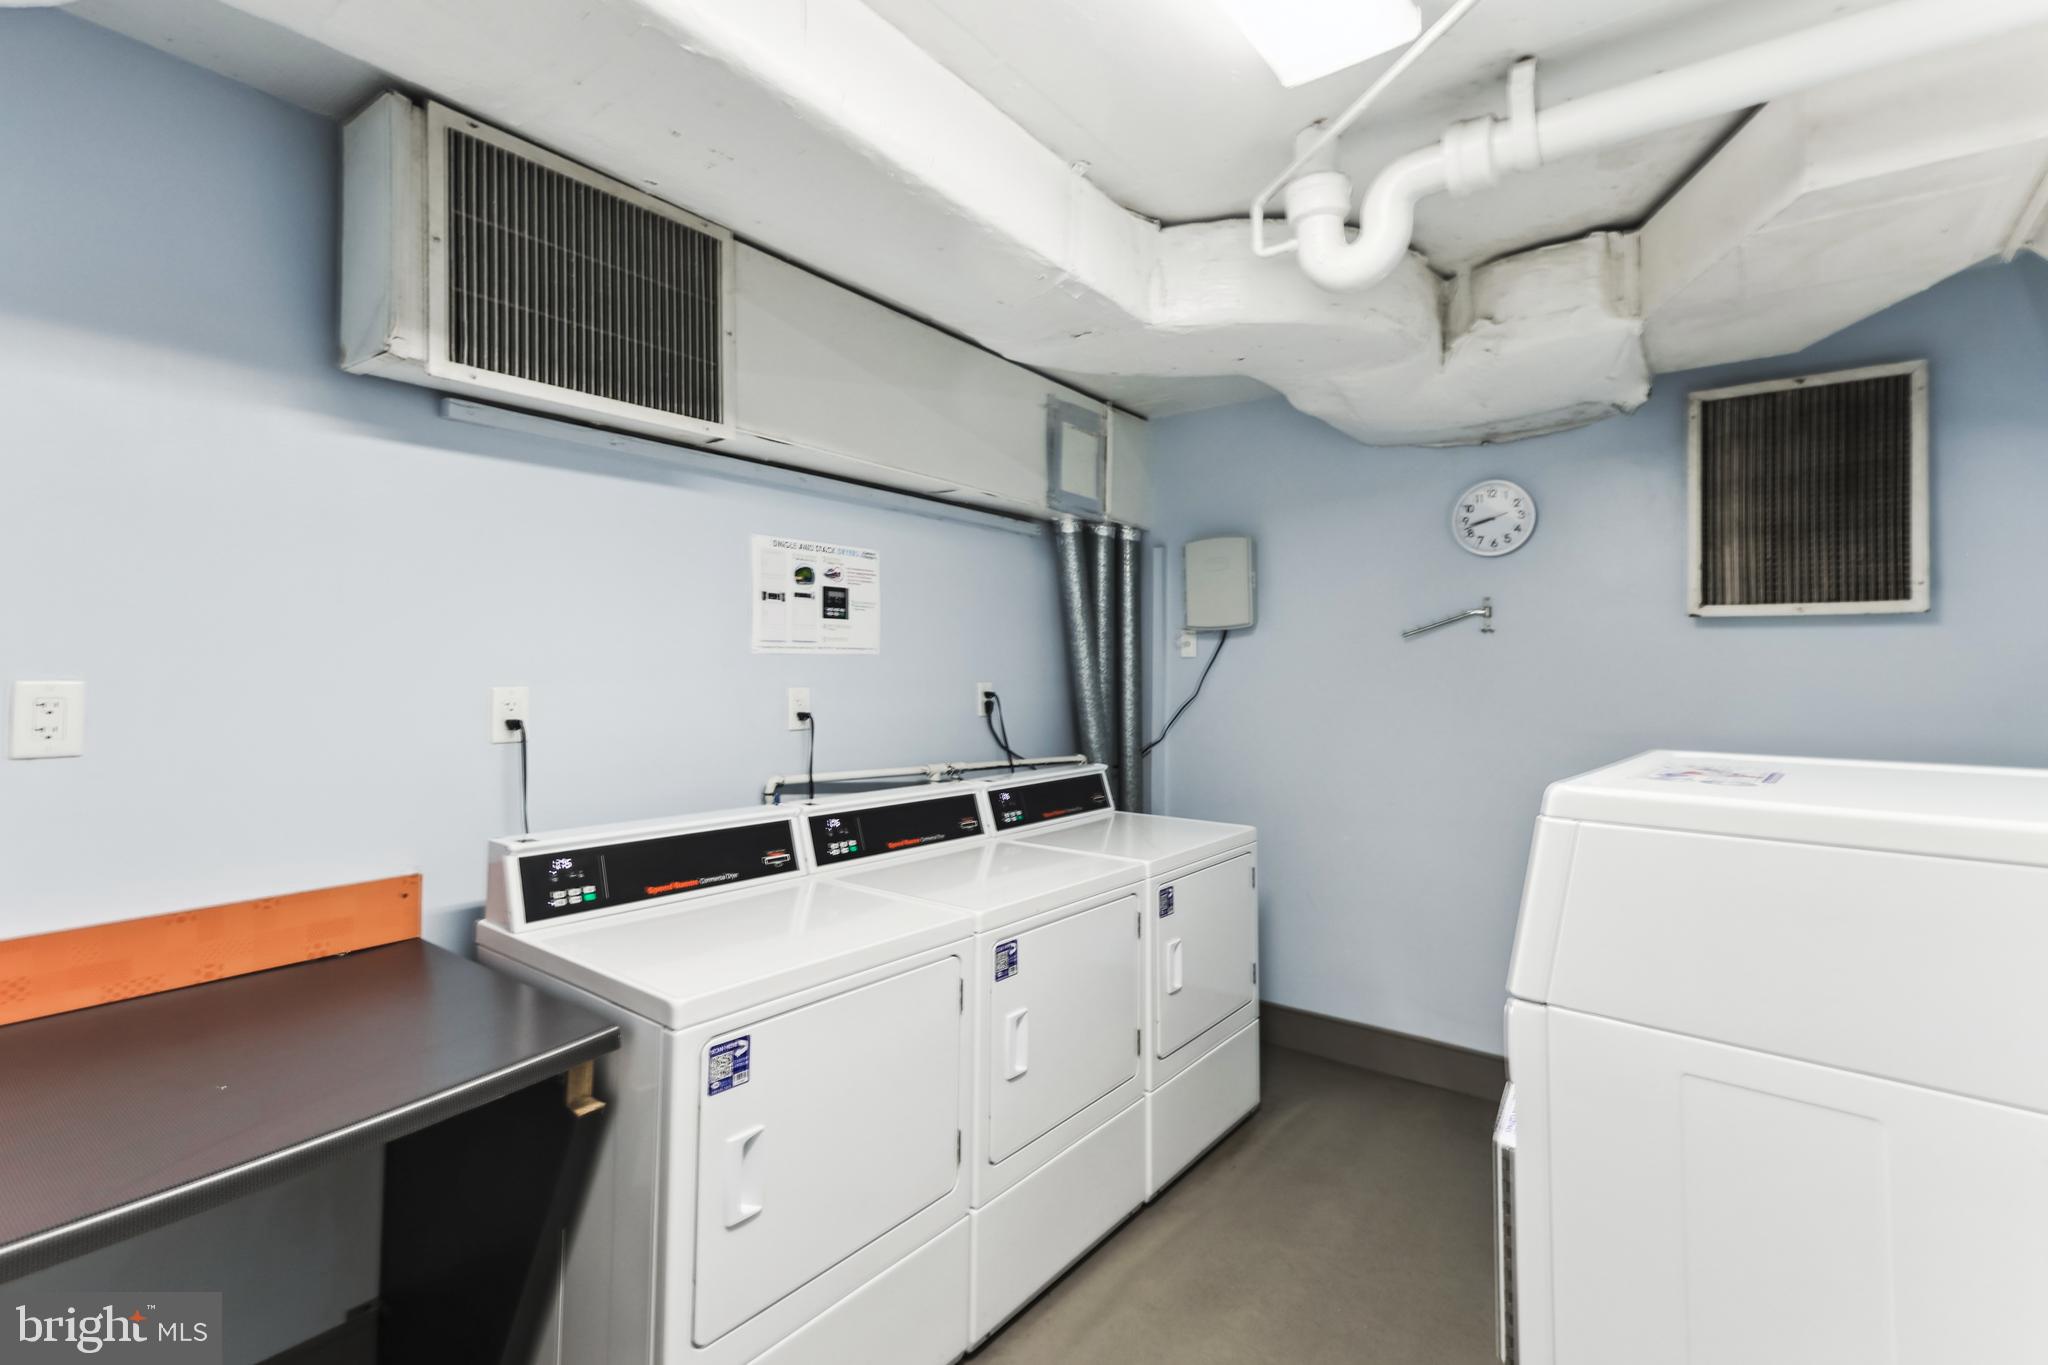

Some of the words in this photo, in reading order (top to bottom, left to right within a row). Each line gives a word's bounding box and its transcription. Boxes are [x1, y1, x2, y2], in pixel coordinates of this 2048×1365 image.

[1487, 488, 1497, 498] 12
[1475, 494, 1484, 503] 11
[1513, 498, 1521, 507] 2
[1464, 504, 1475, 513] 10
[1517, 510, 1526, 519] 3
[1462, 517, 1469, 526] 9
[1514, 524, 1521, 533] 4
[1478, 536, 1485, 545] 7
[1504, 534, 1512, 543] 5
[1491, 539, 1498, 548] 6
